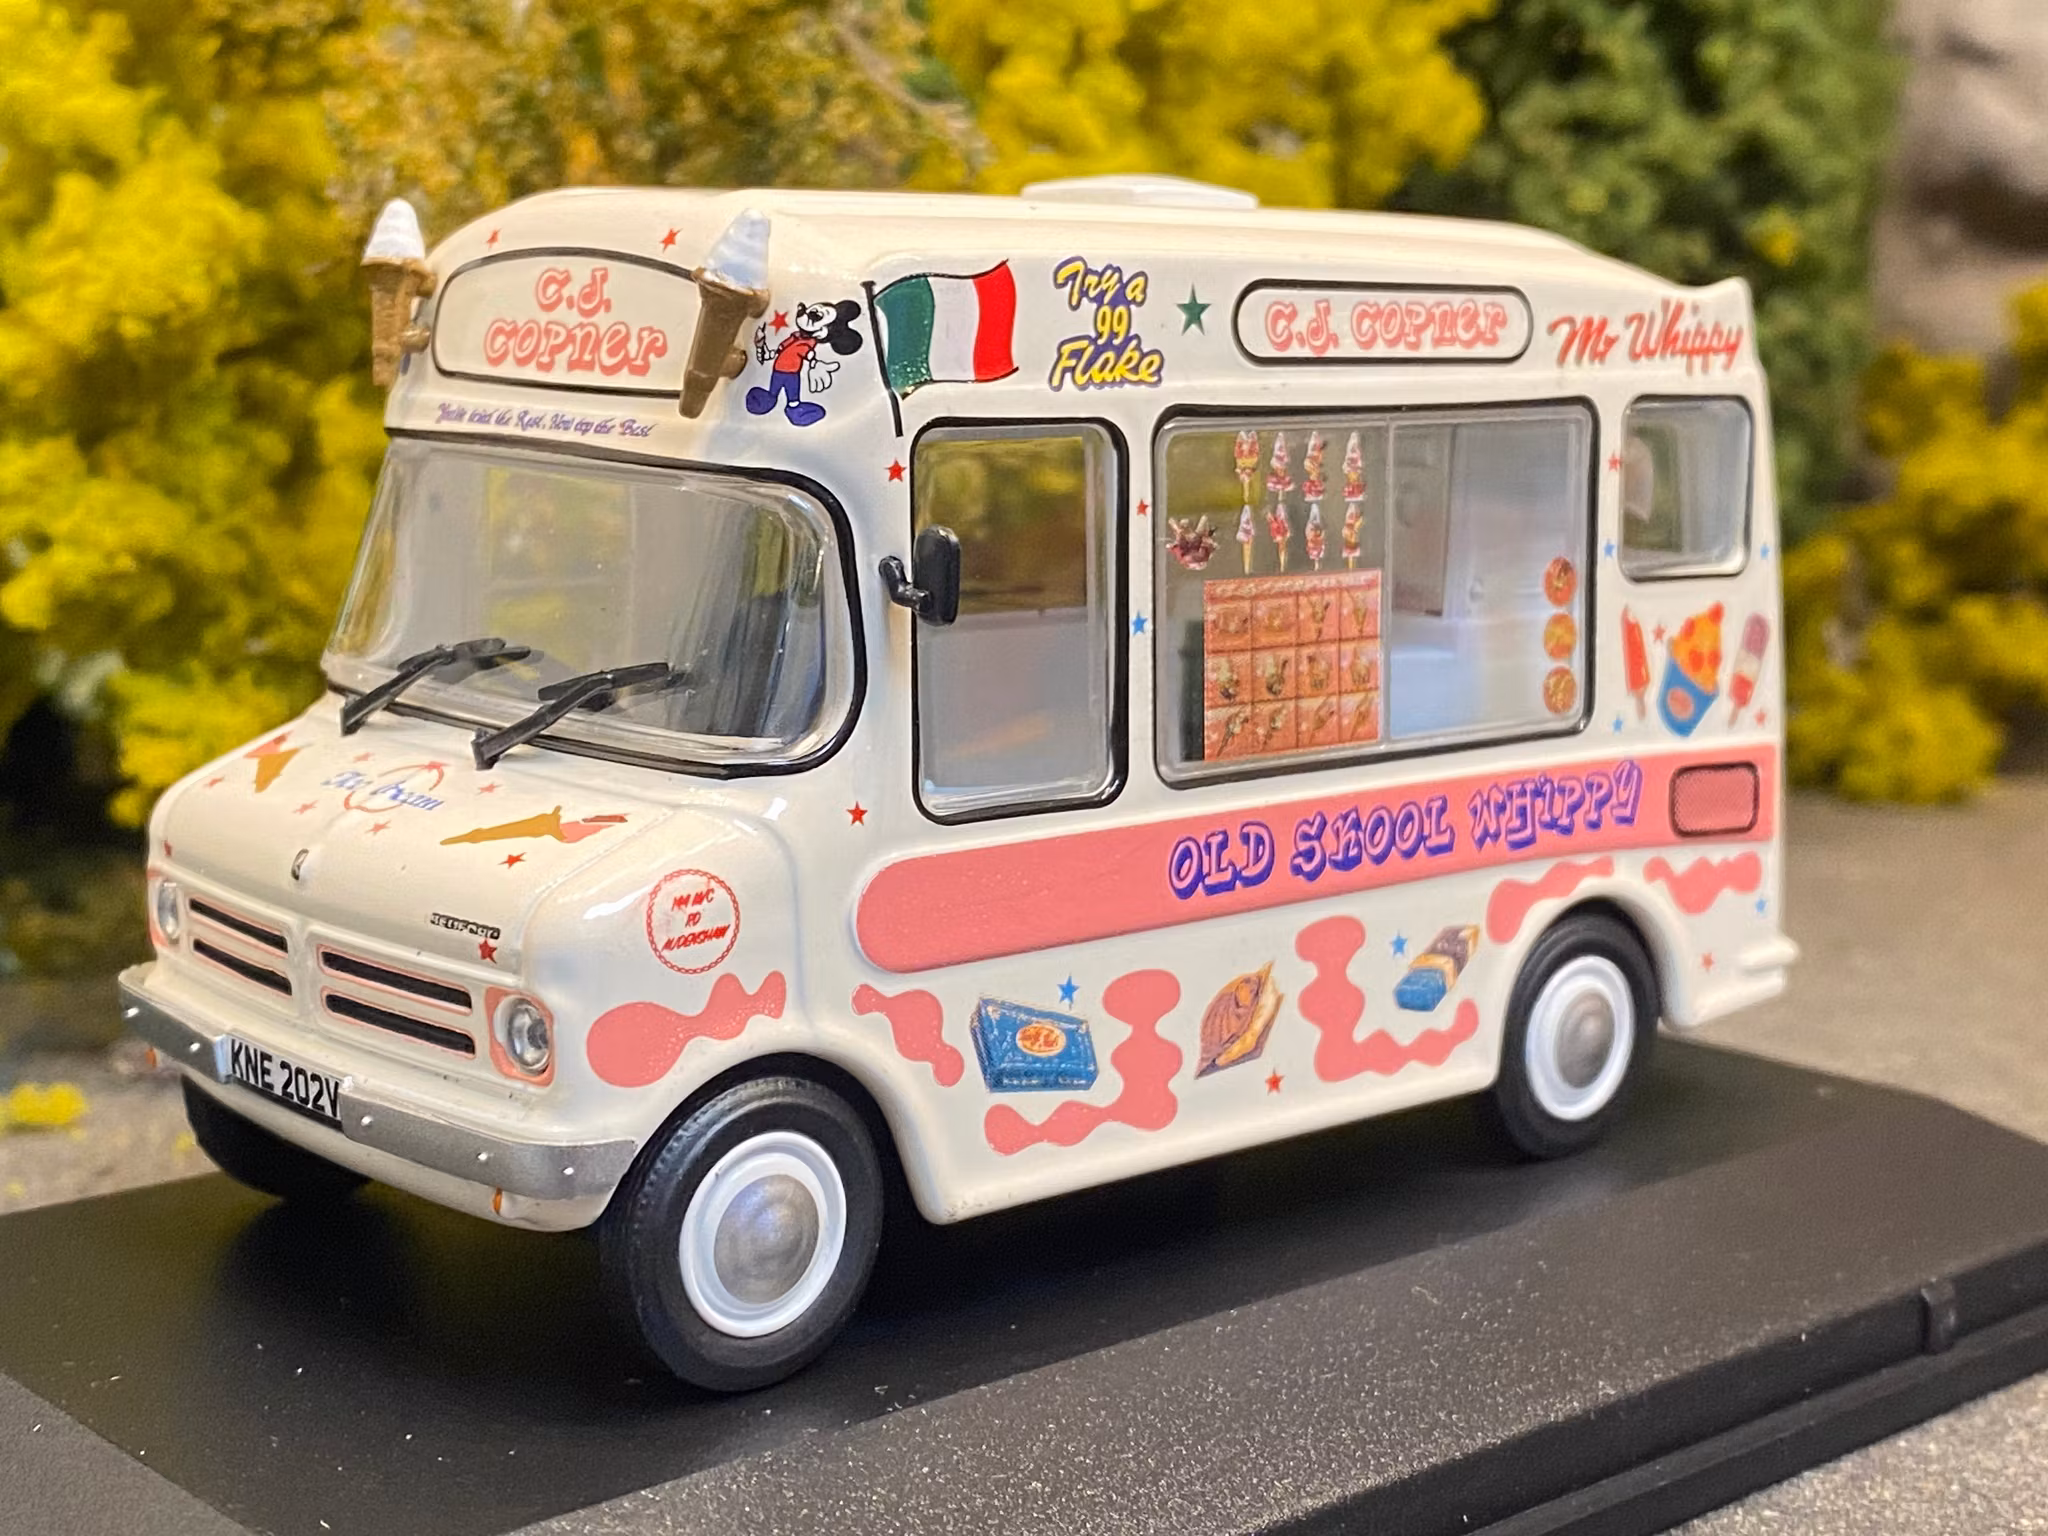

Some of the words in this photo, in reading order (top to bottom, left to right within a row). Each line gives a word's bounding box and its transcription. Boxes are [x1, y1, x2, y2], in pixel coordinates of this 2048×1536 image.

[1053, 256, 1122, 311] Try
[1124, 270, 1148, 307] a
[1048, 333, 1165, 392] Flake
[1547, 315, 1620, 368] Mr
[1624, 298, 1744, 376] Whippy
[1168, 820, 1275, 900] OLD
[1290, 794, 1456, 882] SKOOL
[231, 1038, 275, 1091] KNE
[279, 1060, 340, 1118] 202V
